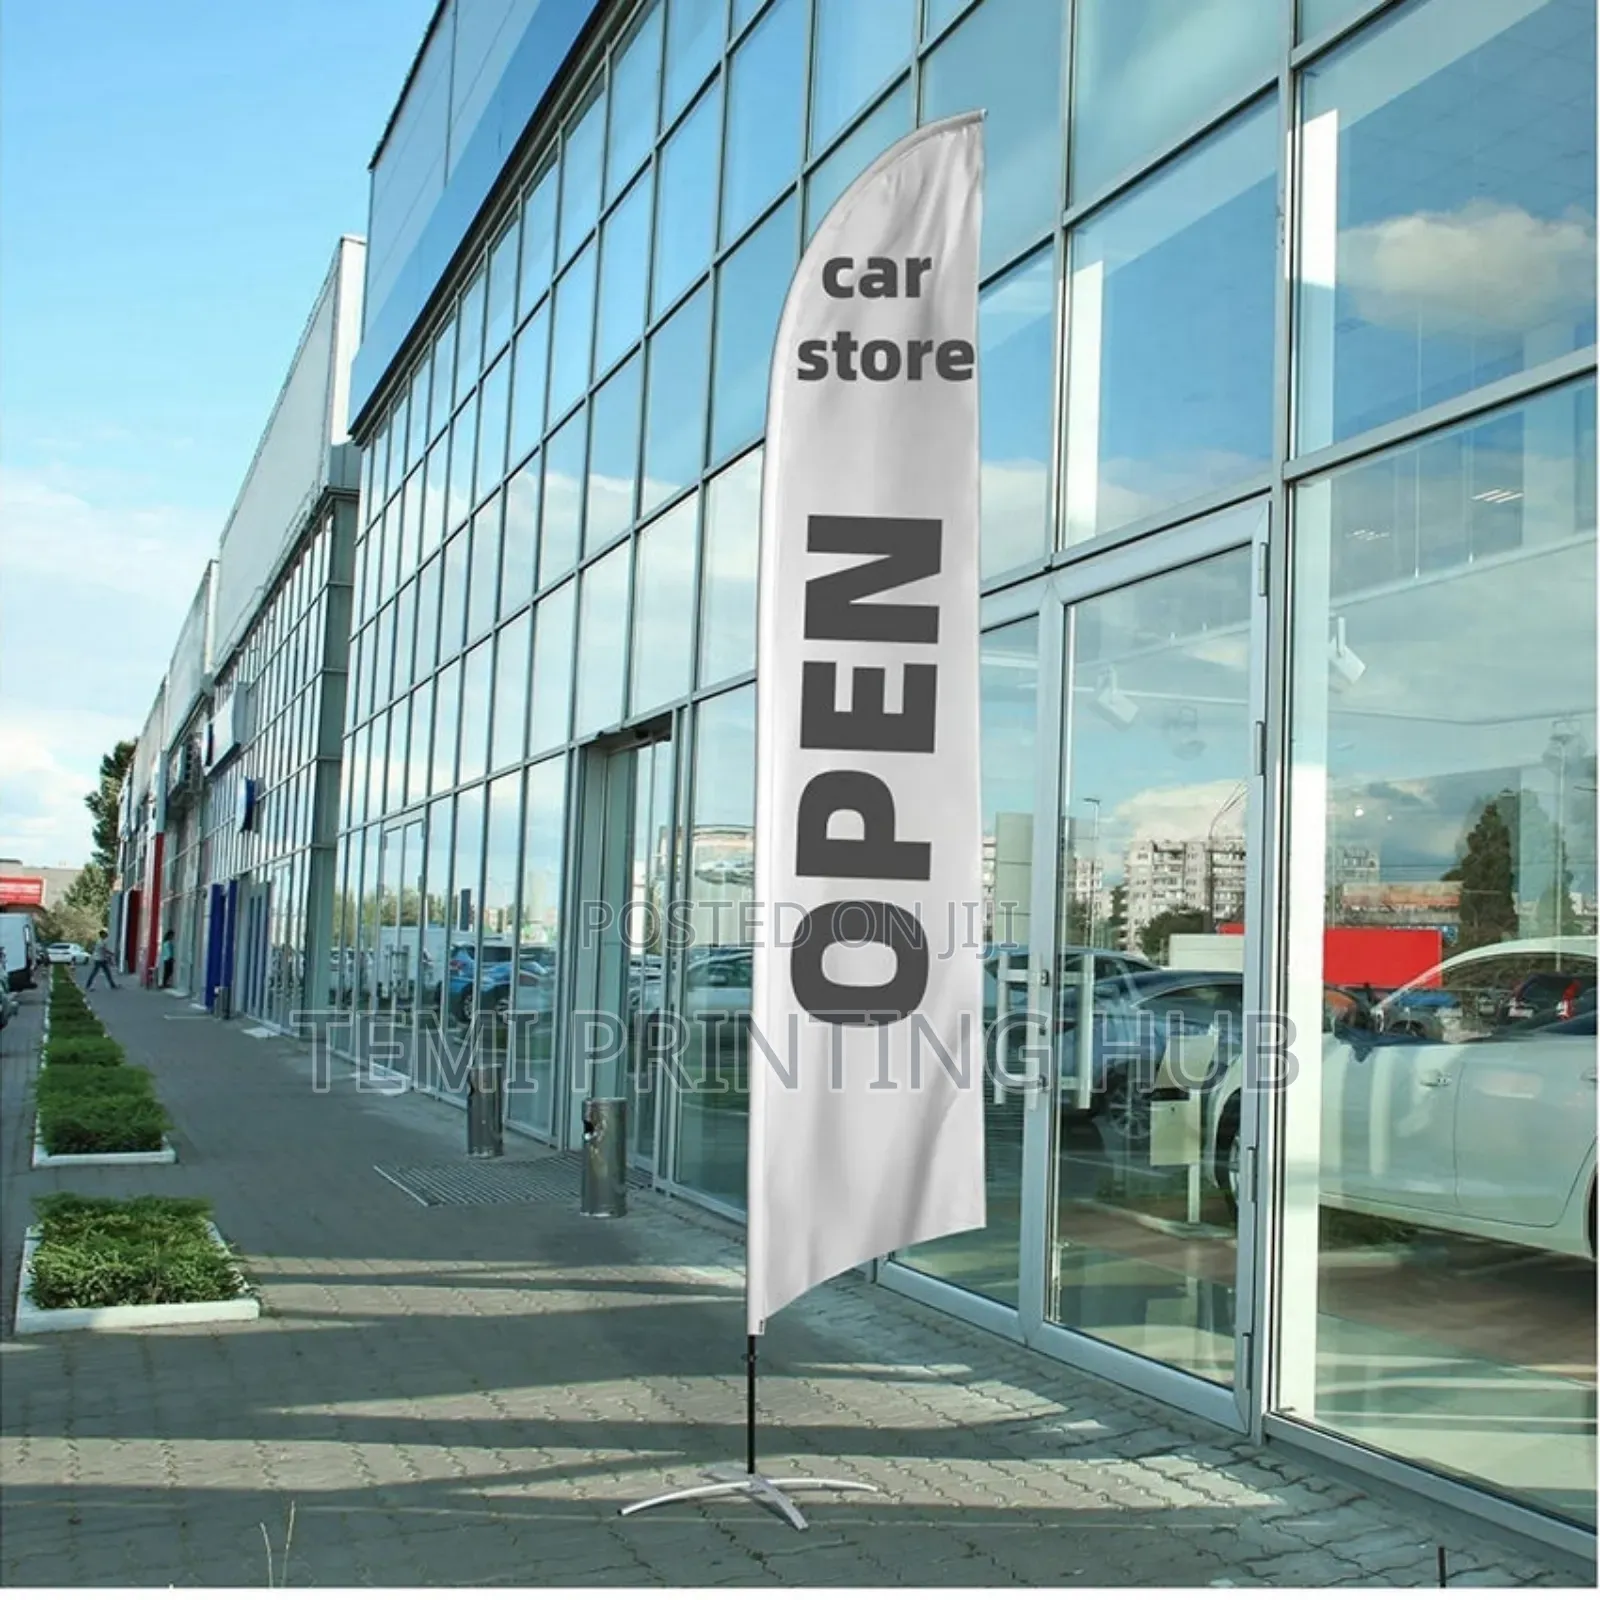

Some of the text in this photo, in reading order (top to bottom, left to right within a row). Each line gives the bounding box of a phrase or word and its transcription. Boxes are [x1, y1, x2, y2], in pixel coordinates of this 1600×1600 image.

[821, 256, 932, 299] car
[797, 331, 975, 381] store
[791, 515, 943, 1027] OPEN
